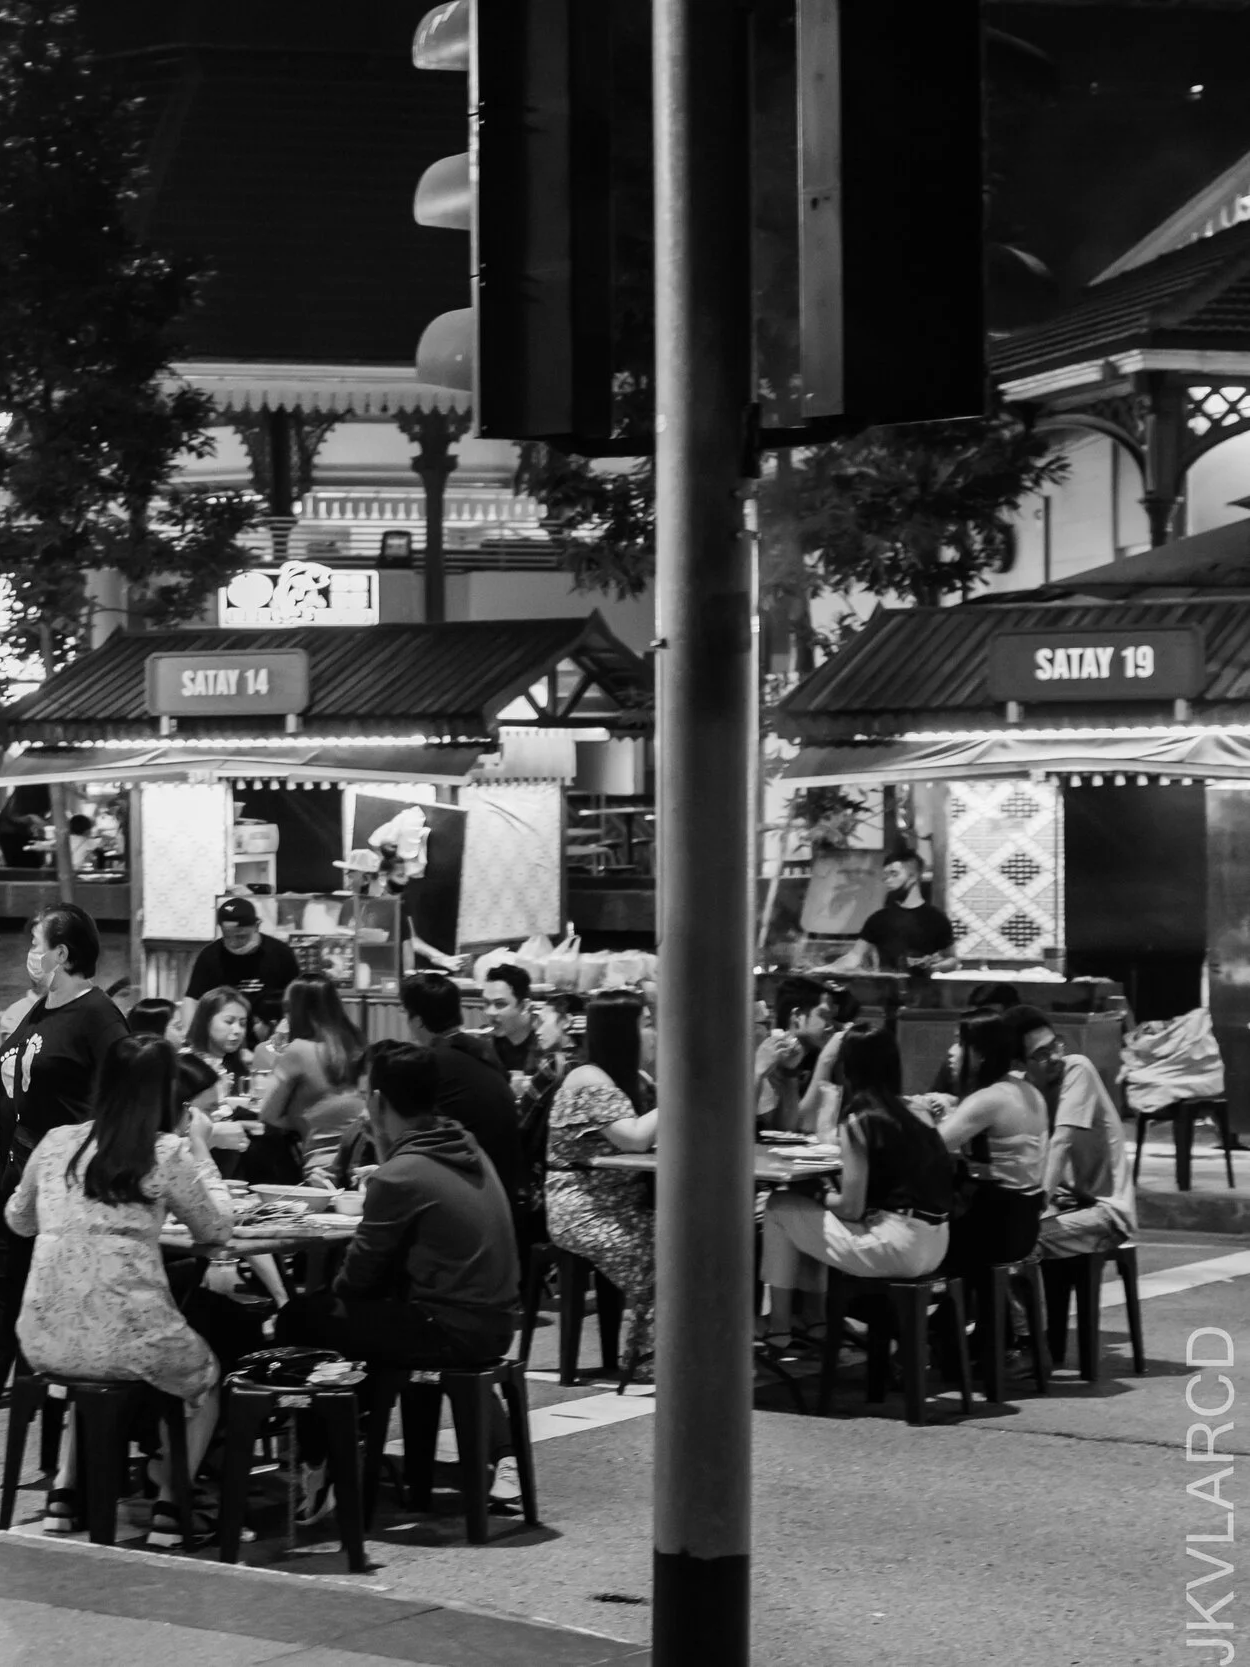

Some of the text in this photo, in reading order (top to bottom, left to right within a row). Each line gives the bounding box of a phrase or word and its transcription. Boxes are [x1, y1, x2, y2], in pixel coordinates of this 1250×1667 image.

[1035, 645, 1154, 680] SATAY 19
[181, 668, 269, 697] SATAY 14
